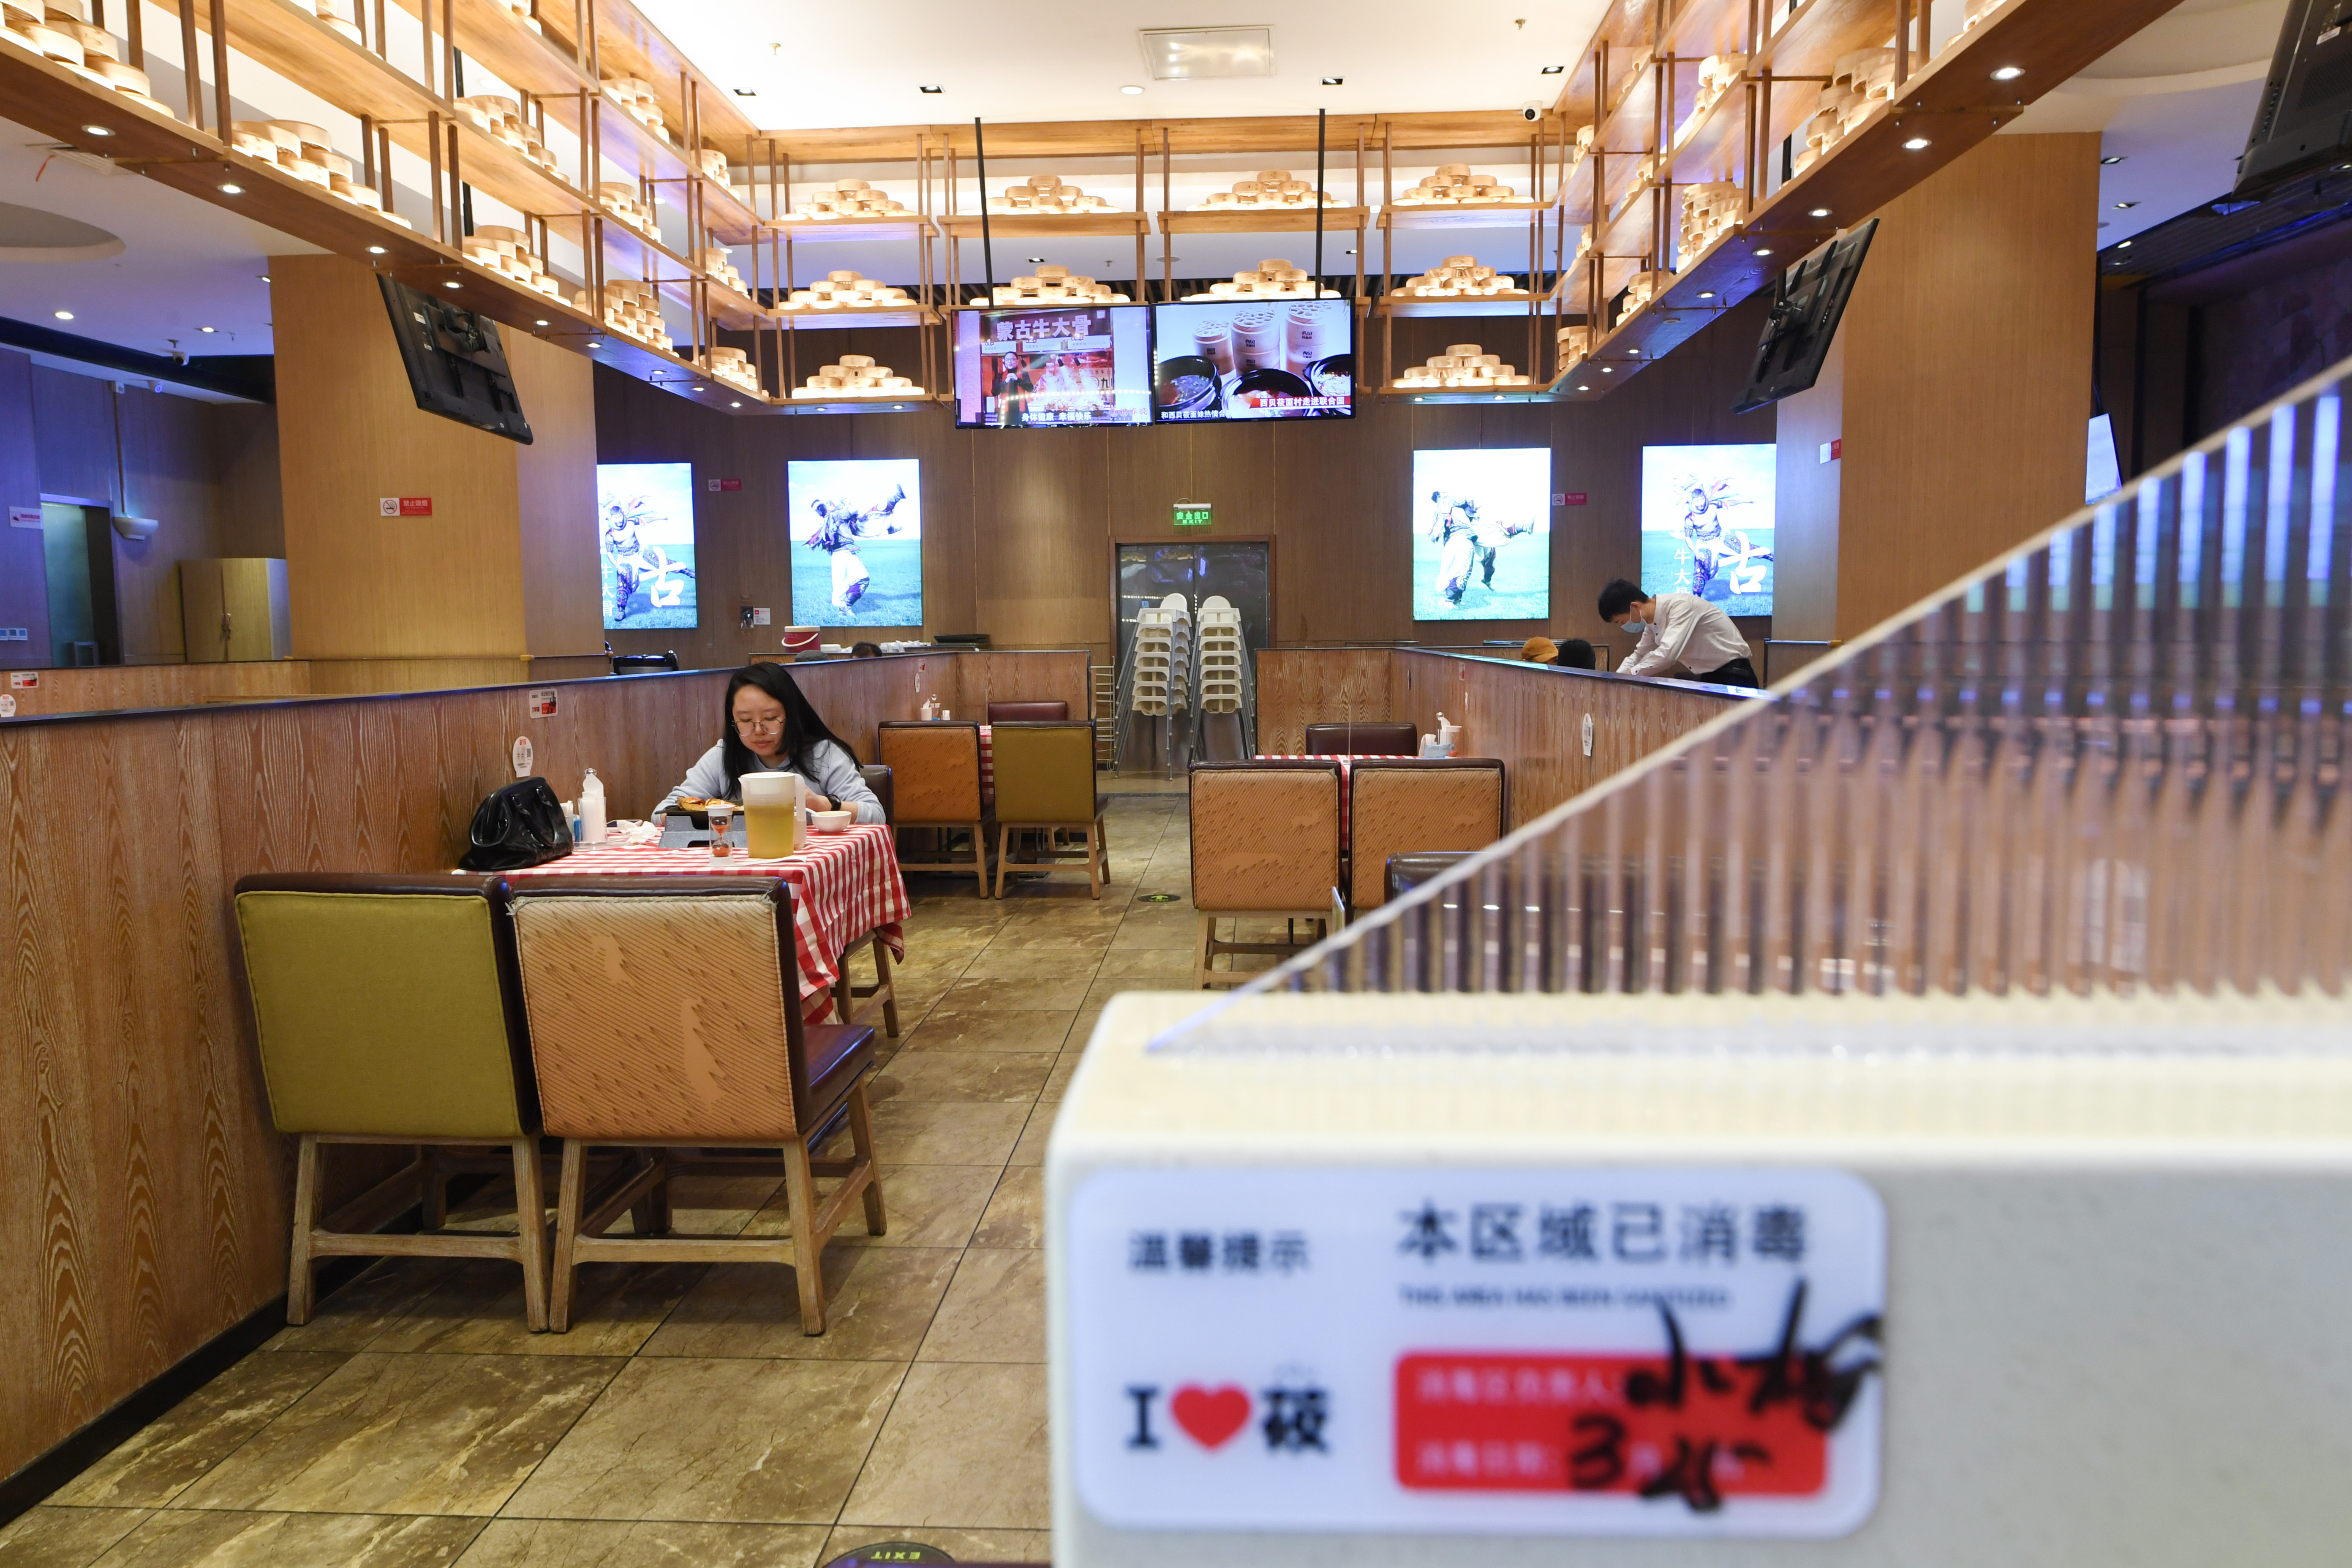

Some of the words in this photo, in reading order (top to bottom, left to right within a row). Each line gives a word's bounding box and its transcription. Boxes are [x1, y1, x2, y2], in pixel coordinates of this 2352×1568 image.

[996, 314, 1092, 341] 蒙古牛大骨
[1021, 412, 1054, 422] 身体健康
[1059, 411, 1092, 421] 幸福快乐
[1259, 396, 1345, 408] 西贝莜面村走进联合国
[1176, 511, 1209, 520] 安全出口
[638, 545, 687, 608] 古
[1718, 530, 1771, 594] 古
[601, 562, 615, 617] 牛大骨
[1128, 1229, 1312, 1277] 温馨提示
[1396, 1199, 1810, 1267] 本区域已消毒
[1124, 1382, 1160, 1451] I
[870, 1551, 921, 1560] EXIT
